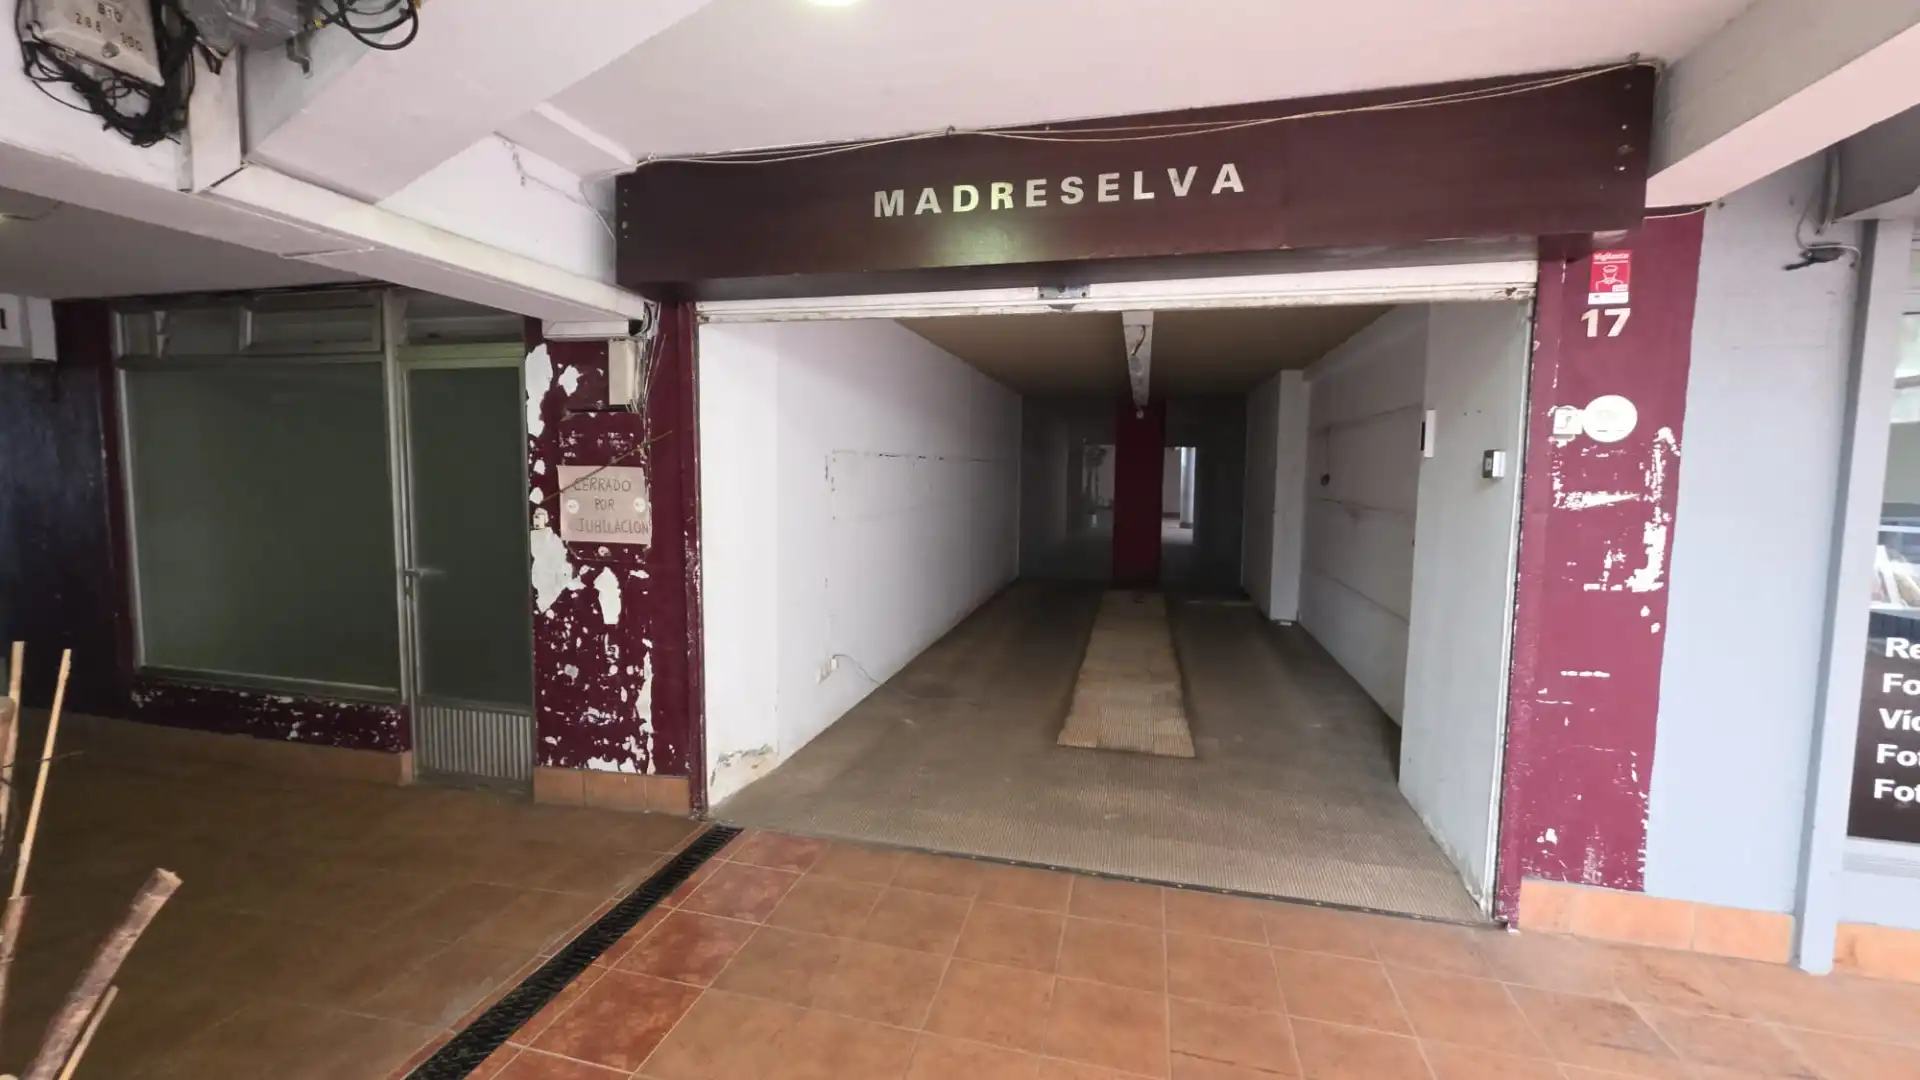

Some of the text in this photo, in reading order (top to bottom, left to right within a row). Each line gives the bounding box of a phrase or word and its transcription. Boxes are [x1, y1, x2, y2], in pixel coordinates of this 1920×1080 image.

[873, 163, 1245, 218] MADRESELVA
[1580, 307, 1631, 338] 17
[573, 477, 632, 493] CERRADO
